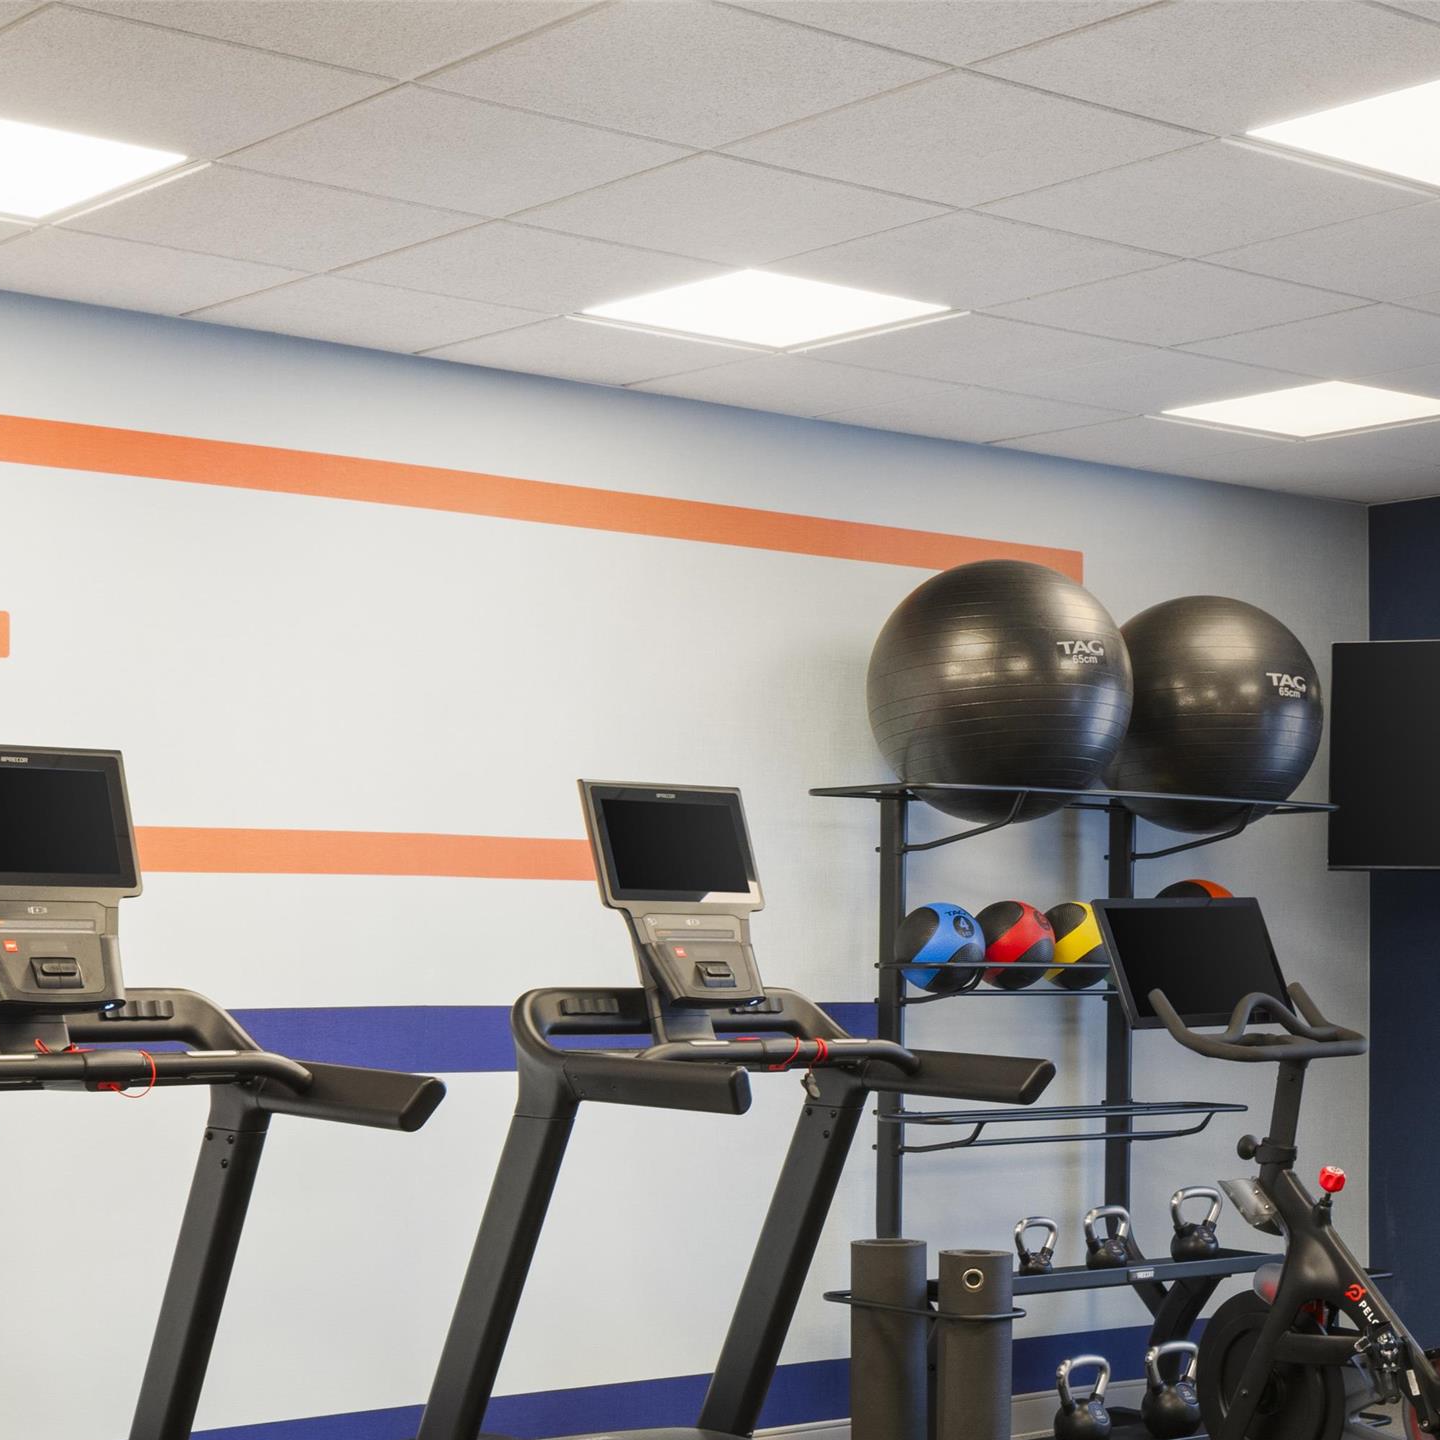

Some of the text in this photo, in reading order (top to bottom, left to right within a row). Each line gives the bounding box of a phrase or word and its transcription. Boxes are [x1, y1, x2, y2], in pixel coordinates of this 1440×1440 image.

[1057, 640, 1104, 656] TAG
[1072, 655, 1098, 665] 65cm
[1266, 672, 1306, 692] TAG
[1279, 687, 1301, 699] 65cm
[959, 917, 970, 931] 4
